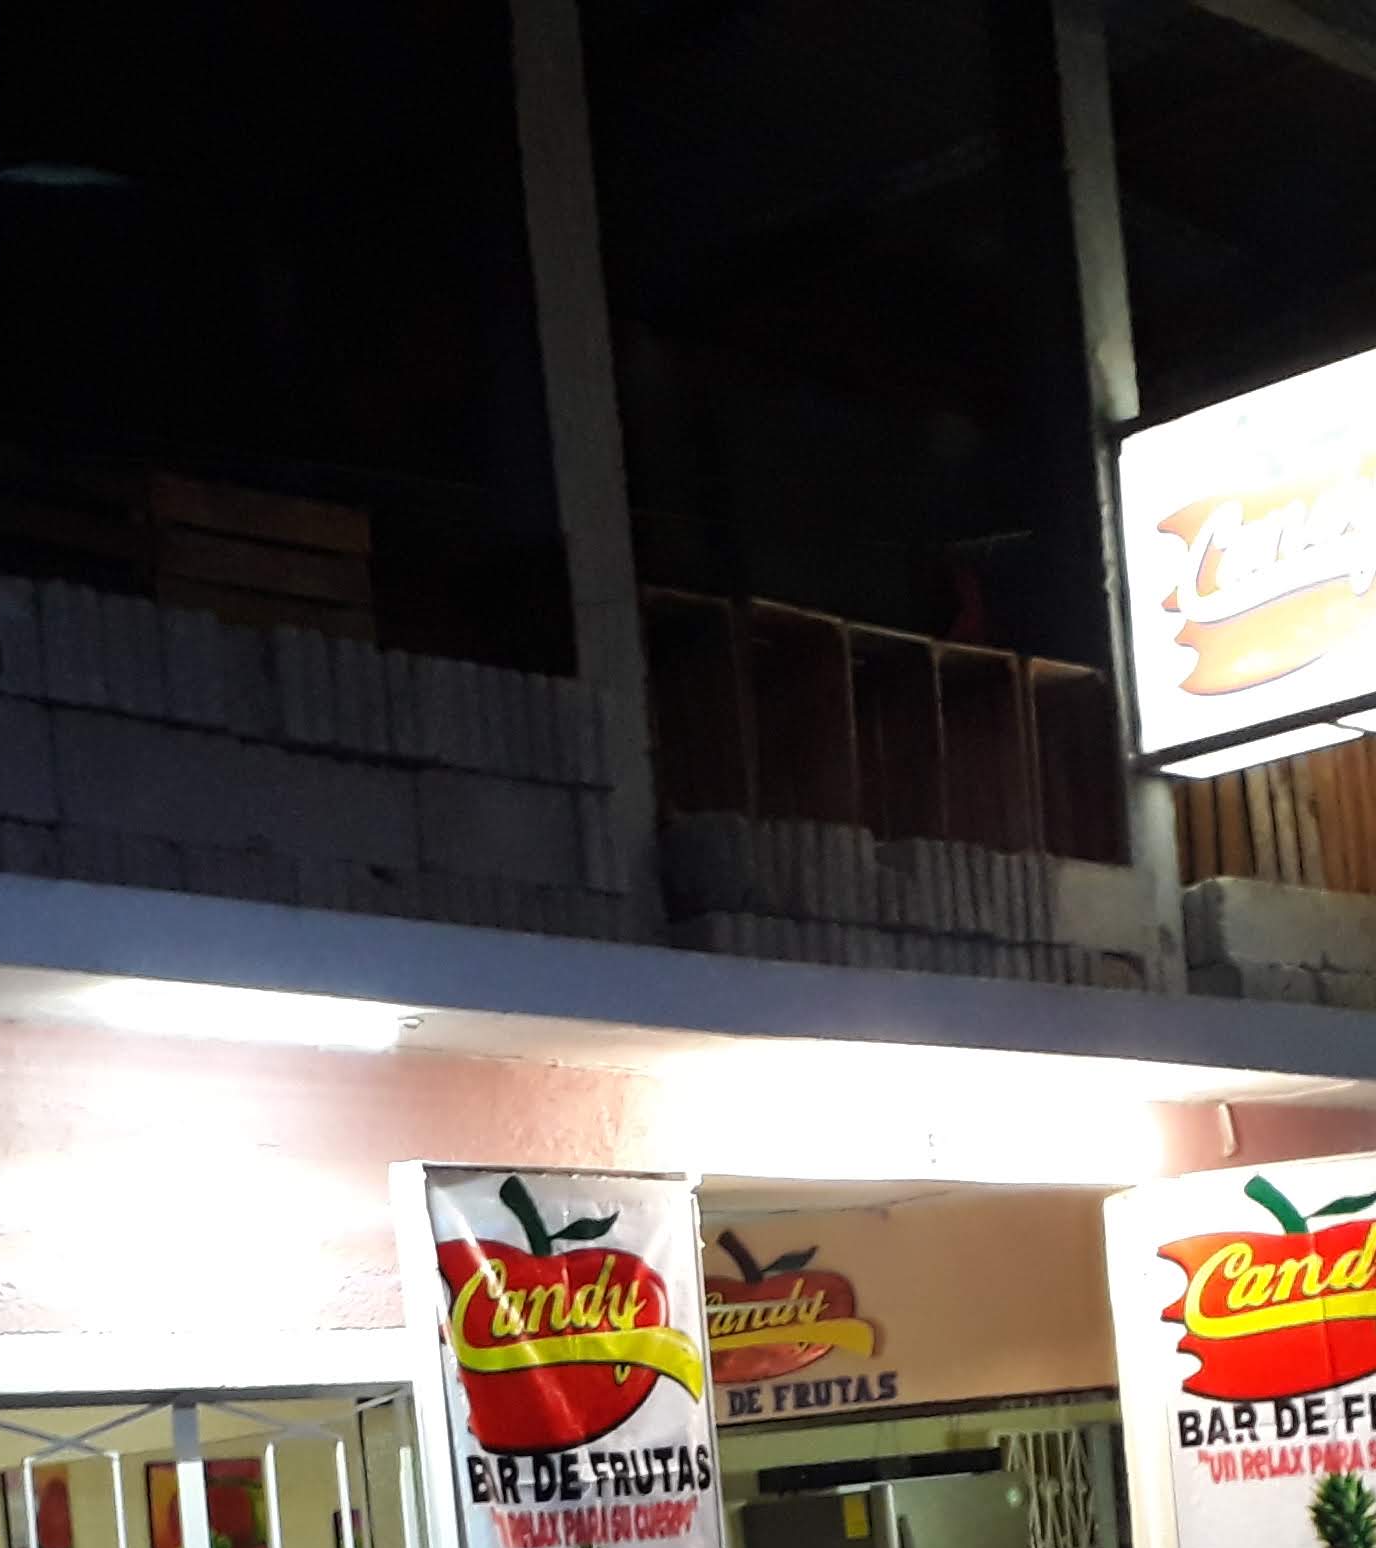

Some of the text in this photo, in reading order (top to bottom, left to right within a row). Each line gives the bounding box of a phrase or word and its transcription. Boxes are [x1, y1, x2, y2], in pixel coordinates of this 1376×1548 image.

[452, 1254, 646, 1384] Candy
[727, 1371, 898, 1416] DE FRUTAS
[1177, 1404, 1258, 1447] BAR
[1274, 1398, 1330, 1438] DE
[532, 1452, 582, 1501] DE
[588, 1444, 711, 1497] FRUTAS
